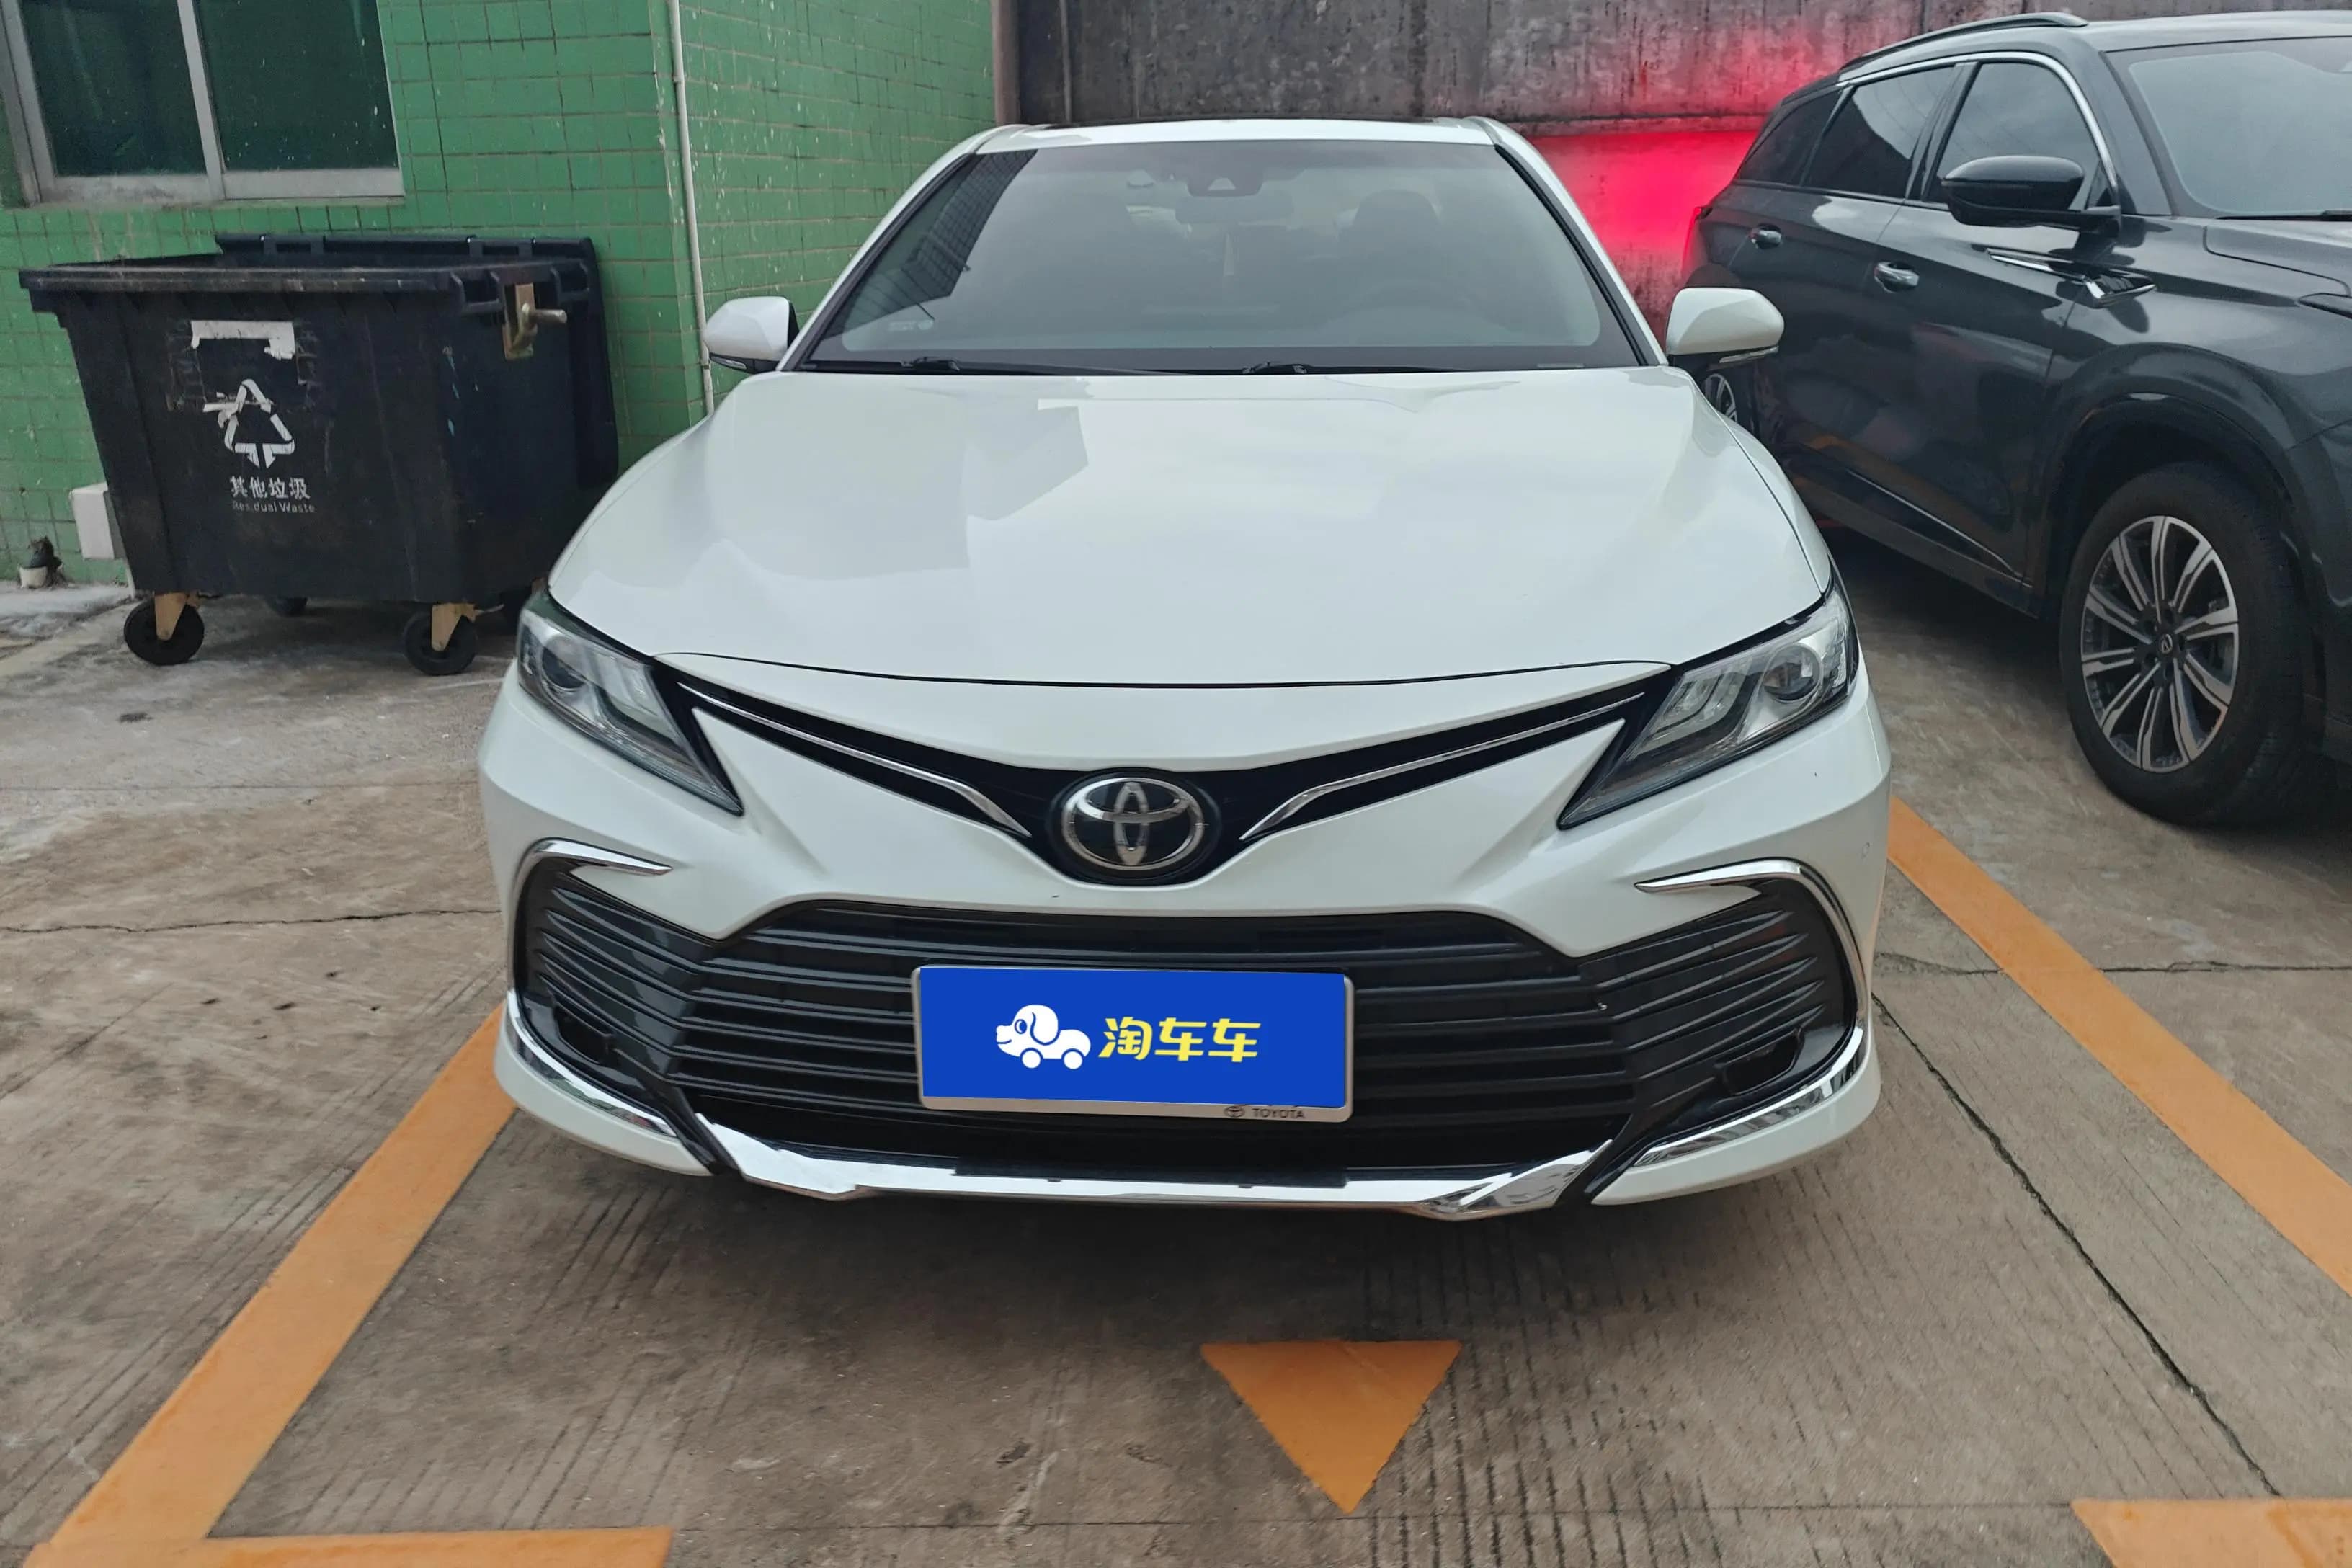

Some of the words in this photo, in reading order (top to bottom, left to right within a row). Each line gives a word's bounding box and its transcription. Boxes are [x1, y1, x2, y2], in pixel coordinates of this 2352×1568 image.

[230, 476, 311, 499] 其他垃圾
[232, 500, 277, 512] Resdual
[278, 502, 316, 513] Waste
[1252, 1108, 1306, 1119] TOYOTA
